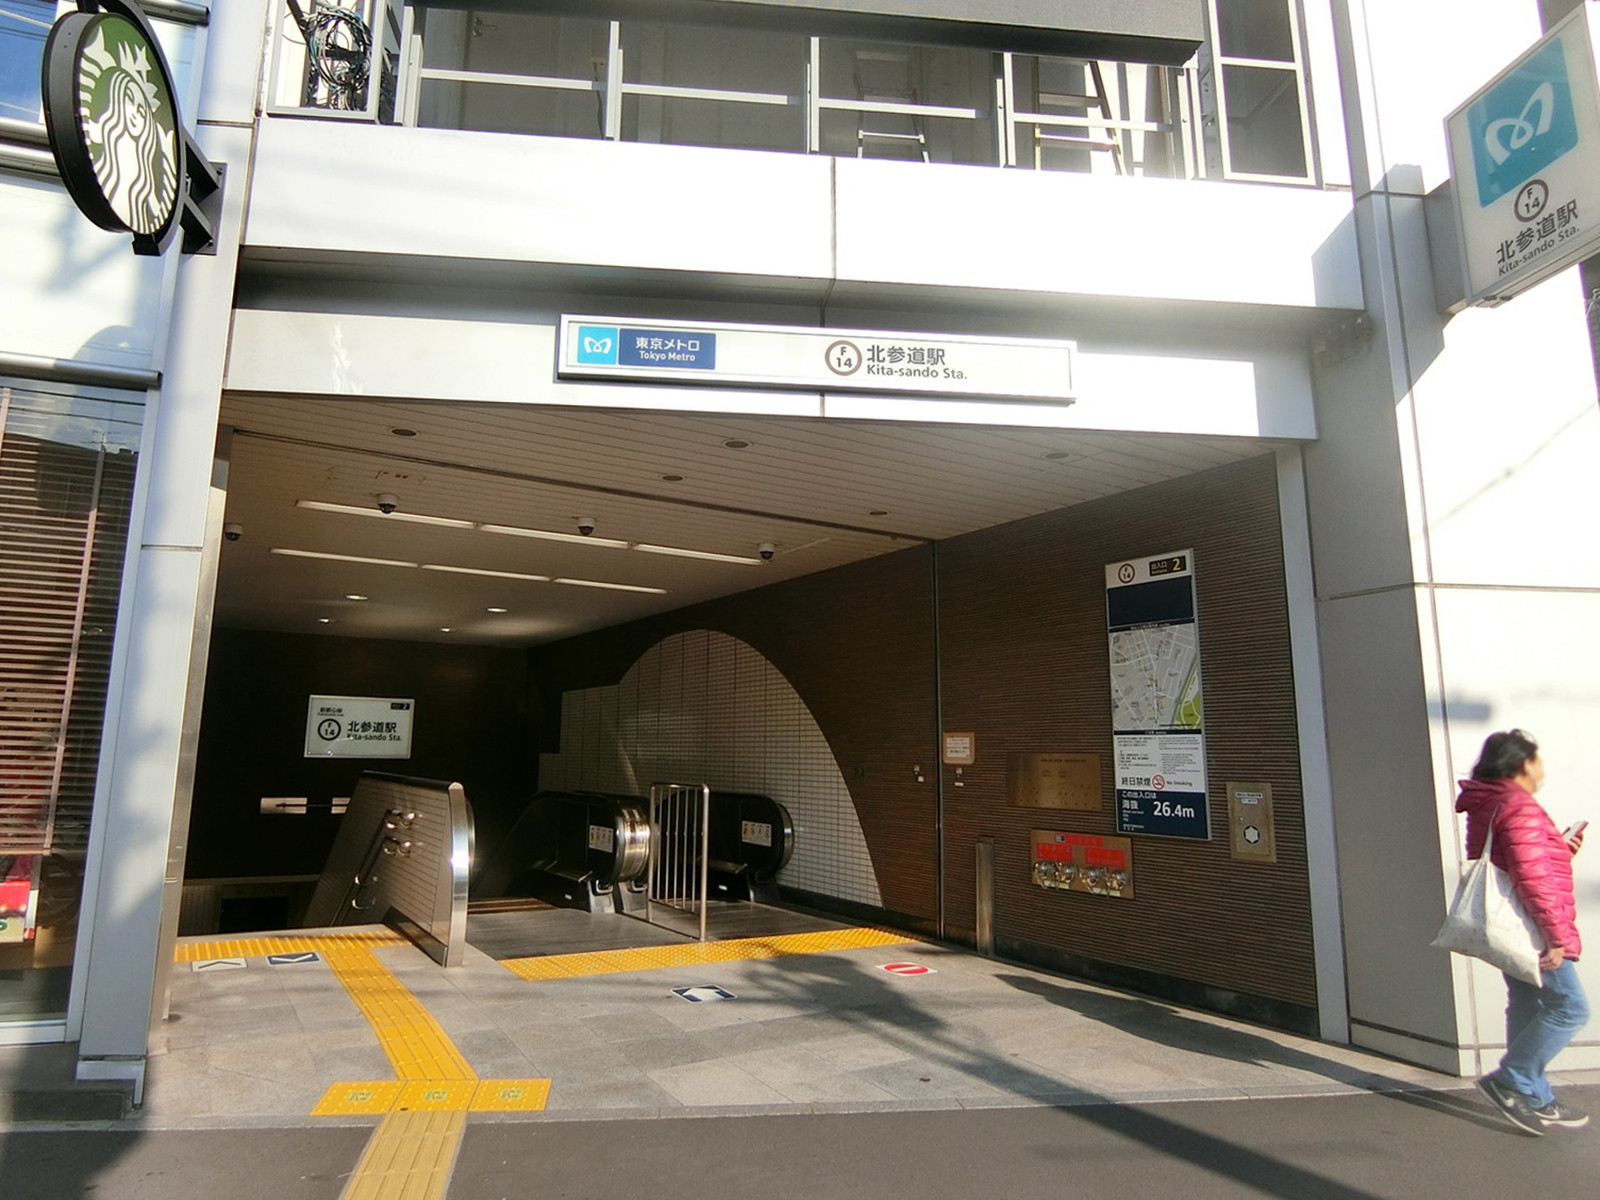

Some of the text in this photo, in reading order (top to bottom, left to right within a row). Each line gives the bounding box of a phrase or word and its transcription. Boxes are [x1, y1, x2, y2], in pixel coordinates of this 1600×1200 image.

[1526, 187, 1533, 199] F
[1524, 197, 1540, 214] 14
[1496, 198, 1578, 265] 北参道駅
[1498, 225, 1580, 276] Kita-sando Sta.
[635, 337, 700, 352] 東京メトロ
[840, 346, 847, 356] F
[639, 350, 696, 362] Tokyo Metro
[866, 344, 946, 366] 北参道駅
[836, 357, 853, 368] 14
[867, 364, 968, 380] Kita-sando Sta.
[1172, 558, 1181, 571] 2
[324, 728, 335, 736] 14
[347, 721, 397, 733] 北参道駅
[1153, 801, 1195, 818] 26.4m
